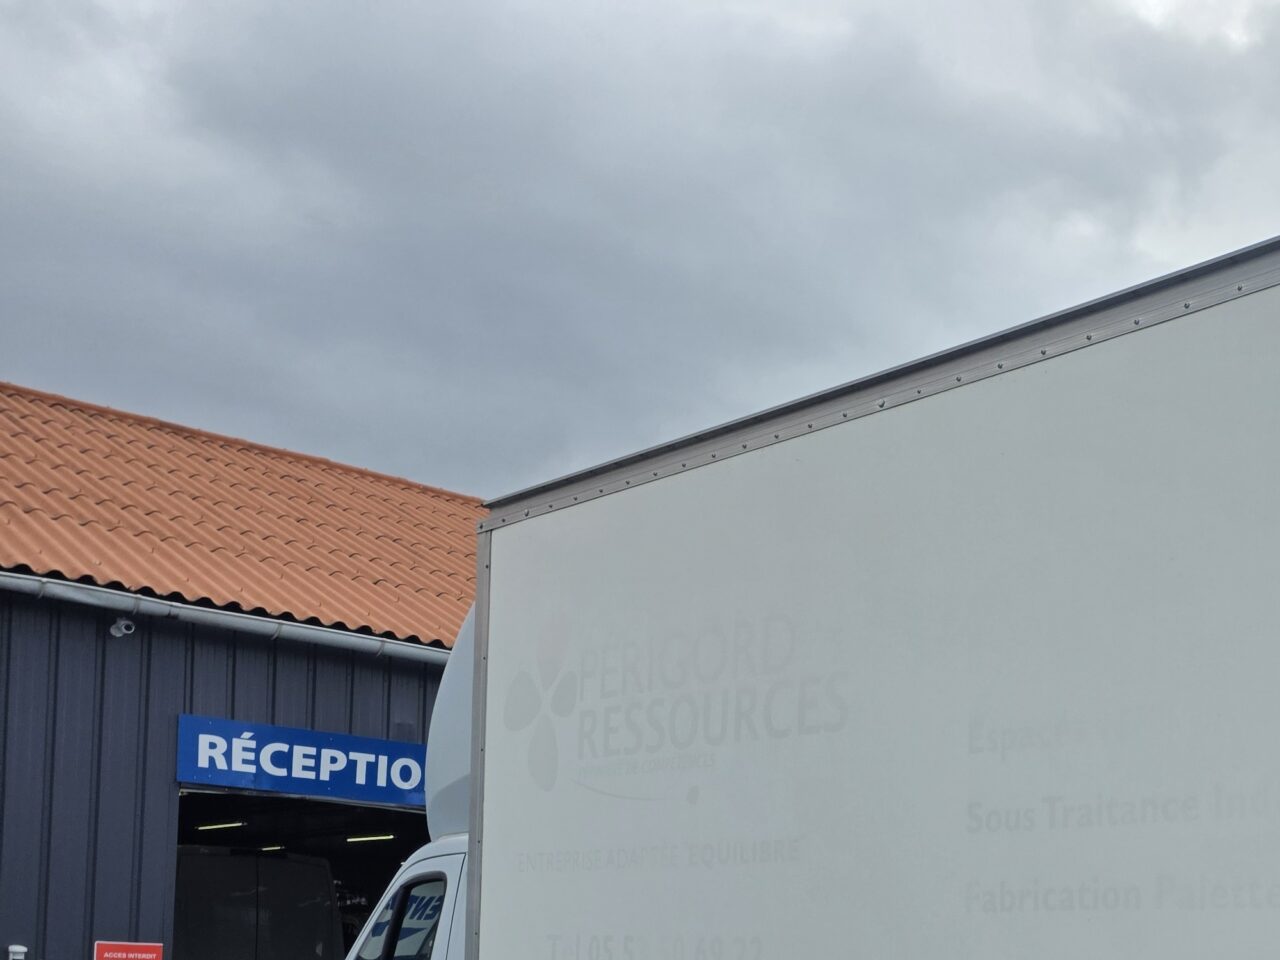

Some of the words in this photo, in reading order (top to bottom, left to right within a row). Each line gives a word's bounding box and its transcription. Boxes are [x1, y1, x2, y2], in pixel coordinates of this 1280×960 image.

[578, 670, 850, 760] RESSOURCES
[197, 731, 424, 790] RÉCEPTIO
[965, 800, 1037, 834] Sous
[1041, 793, 1200, 831] Traitance
[964, 876, 1142, 913] Fabrication
[128, 952, 156, 960] INTERDIT
